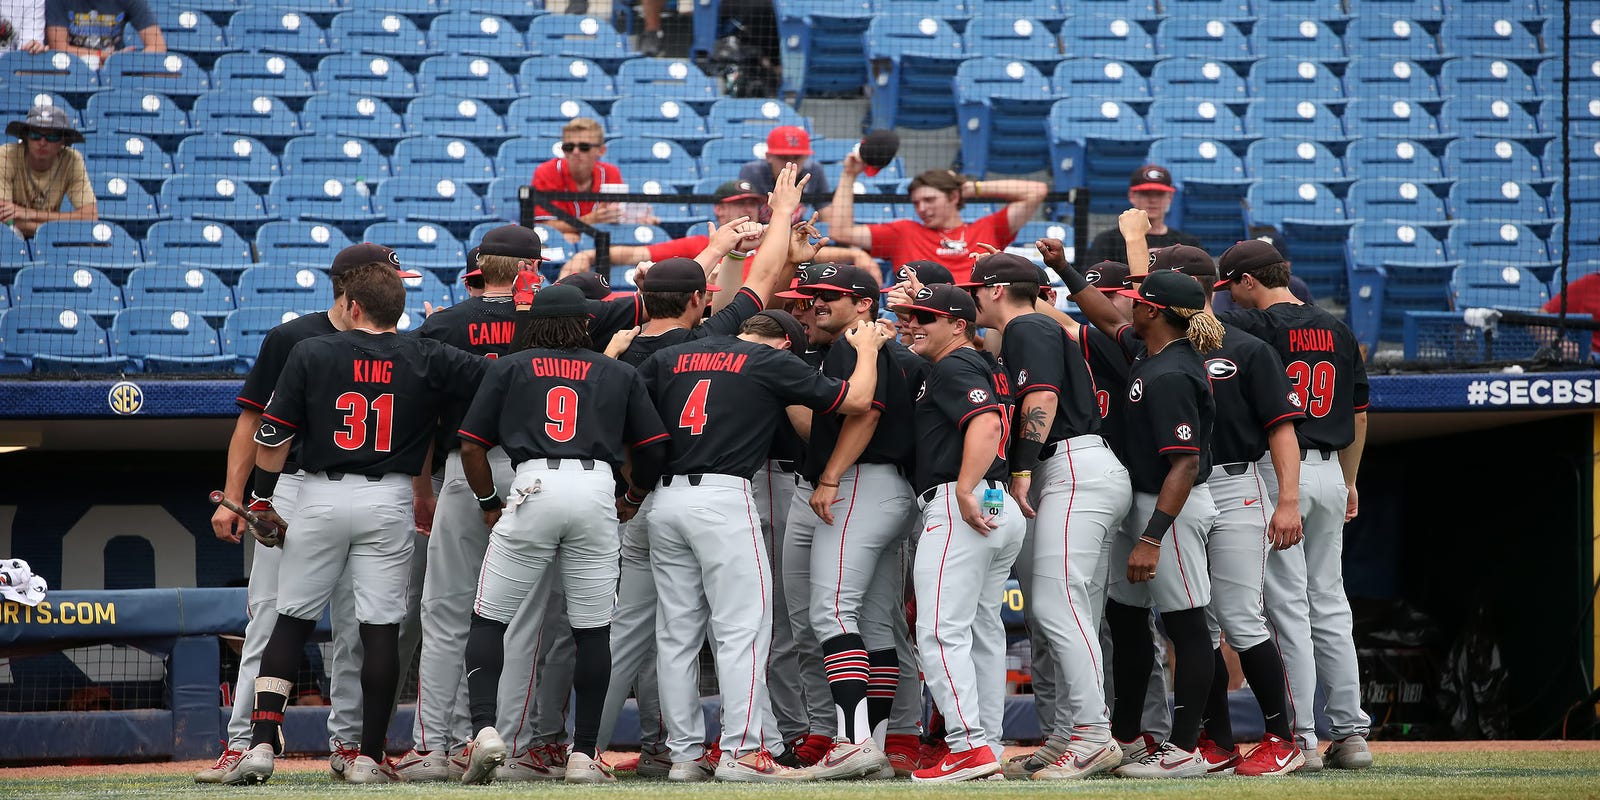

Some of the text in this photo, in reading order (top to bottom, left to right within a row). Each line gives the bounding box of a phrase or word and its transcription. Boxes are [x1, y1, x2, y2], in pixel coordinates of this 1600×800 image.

[468, 321, 516, 346] CANN
[1289, 328, 1334, 352] PASQUA
[353, 359, 393, 384] KING
[531, 357, 592, 380] GUIDRY
[673, 351, 748, 374] JERNIGAN
[112, 385, 140, 412] SEC
[1286, 360, 1336, 418] 39
[545, 385, 578, 442] 9
[679, 379, 711, 435] 4
[333, 391, 394, 452] 31
[0, 601, 116, 625] RTS.COM
